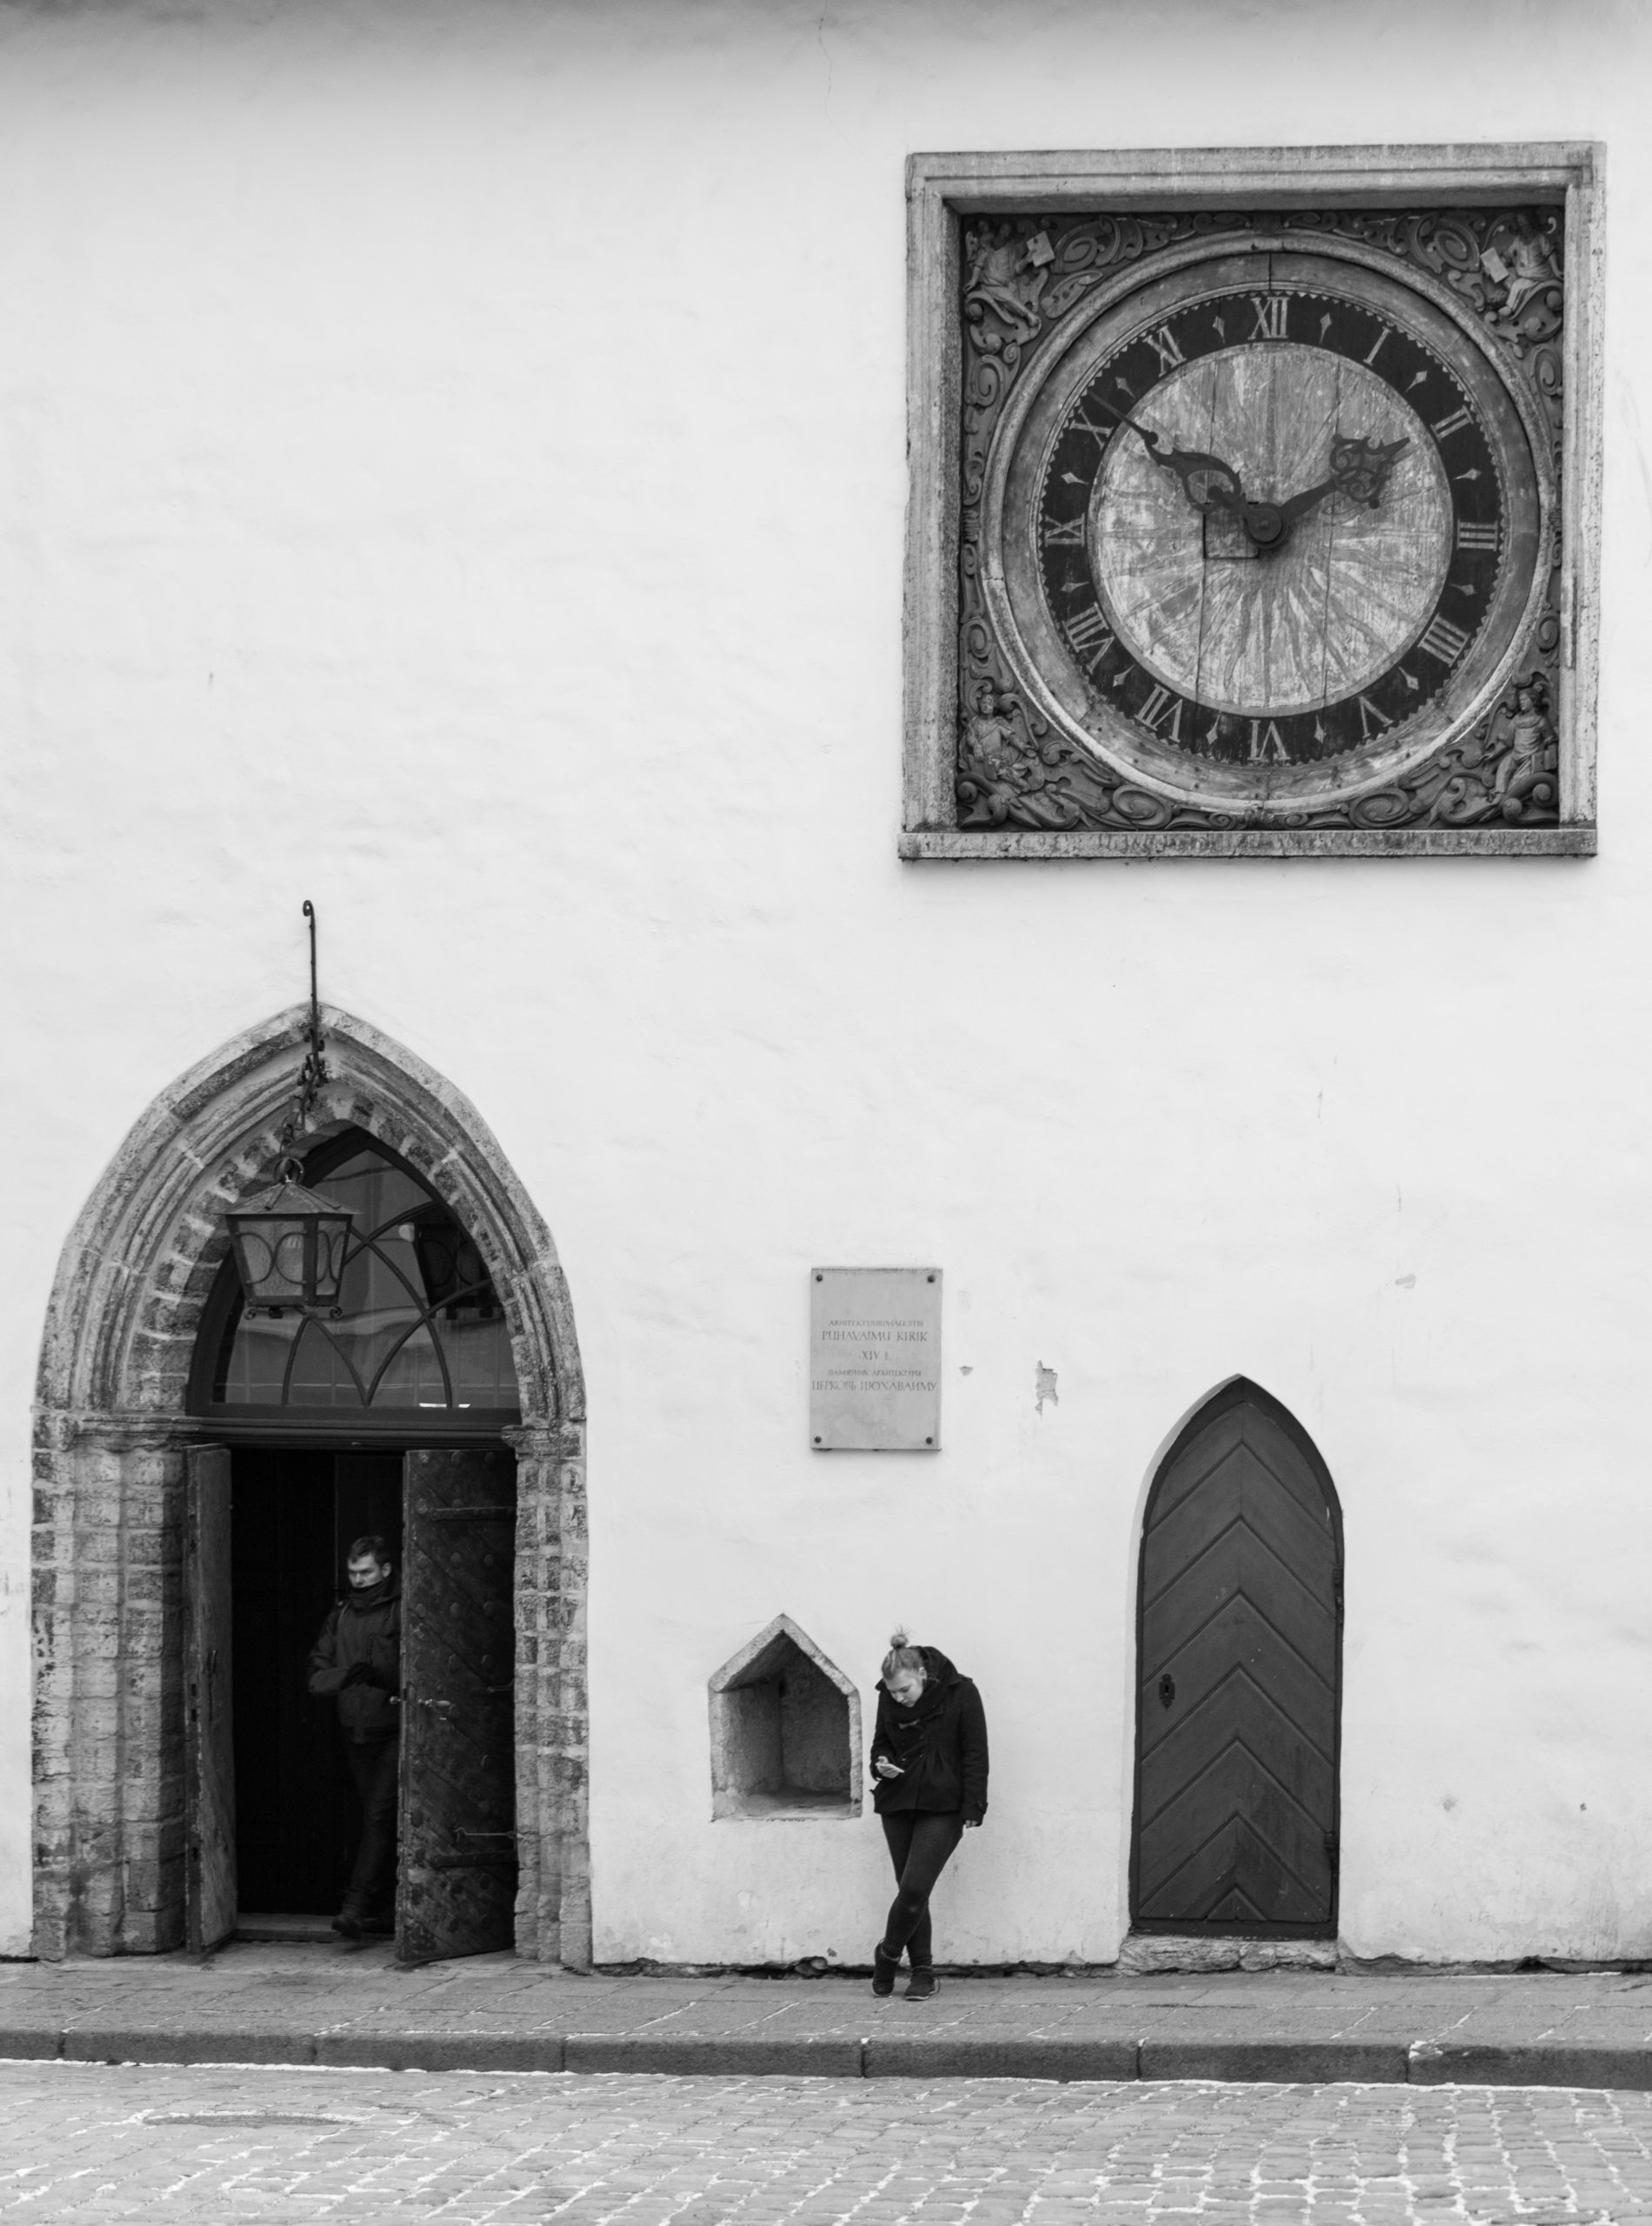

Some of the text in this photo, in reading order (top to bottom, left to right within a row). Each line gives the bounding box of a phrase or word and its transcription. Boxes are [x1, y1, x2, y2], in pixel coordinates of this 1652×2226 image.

[1248, 297, 1289, 340] XII
[1143, 325, 1187, 377] XI
[1362, 325, 1392, 366] I
[1069, 410, 1114, 450] X
[1429, 405, 1475, 442] II
[1046, 516, 1085, 548] IX
[1456, 521, 1499, 552] III
[1061, 607, 1115, 675] VIII
[1417, 616, 1471, 668] IIII
[1134, 683, 1184, 743] VII
[1358, 696, 1394, 738] V
[1247, 720, 1290, 763] VI
[862, 1350, 880, 1361] XIV
[896, 1330, 929, 1343] KIRIK
